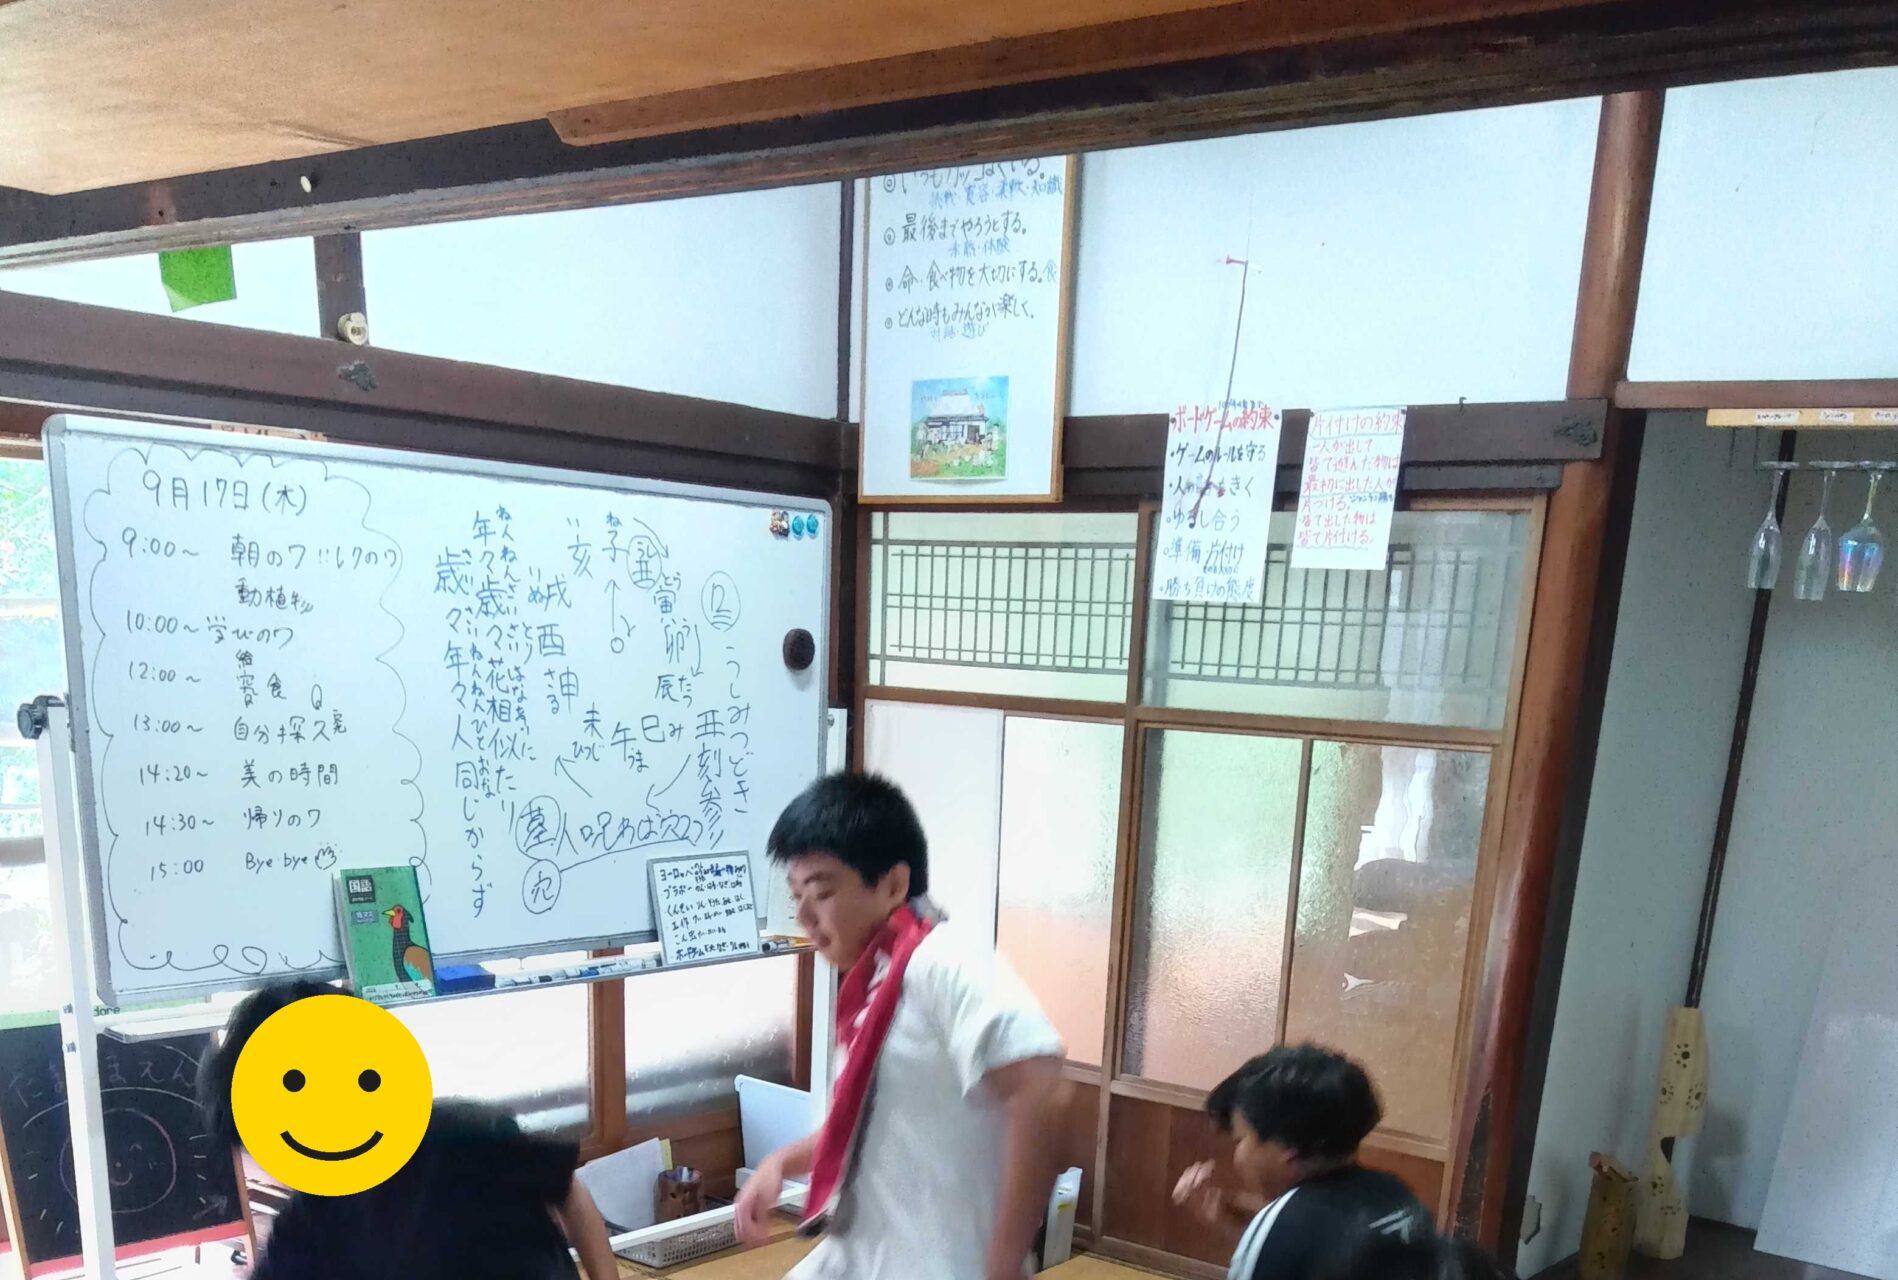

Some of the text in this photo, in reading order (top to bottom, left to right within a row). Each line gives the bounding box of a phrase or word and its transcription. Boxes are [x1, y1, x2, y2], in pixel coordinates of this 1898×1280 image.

[241, 759, 338, 788] 美の時間
[150, 858, 204, 880] 15:00
